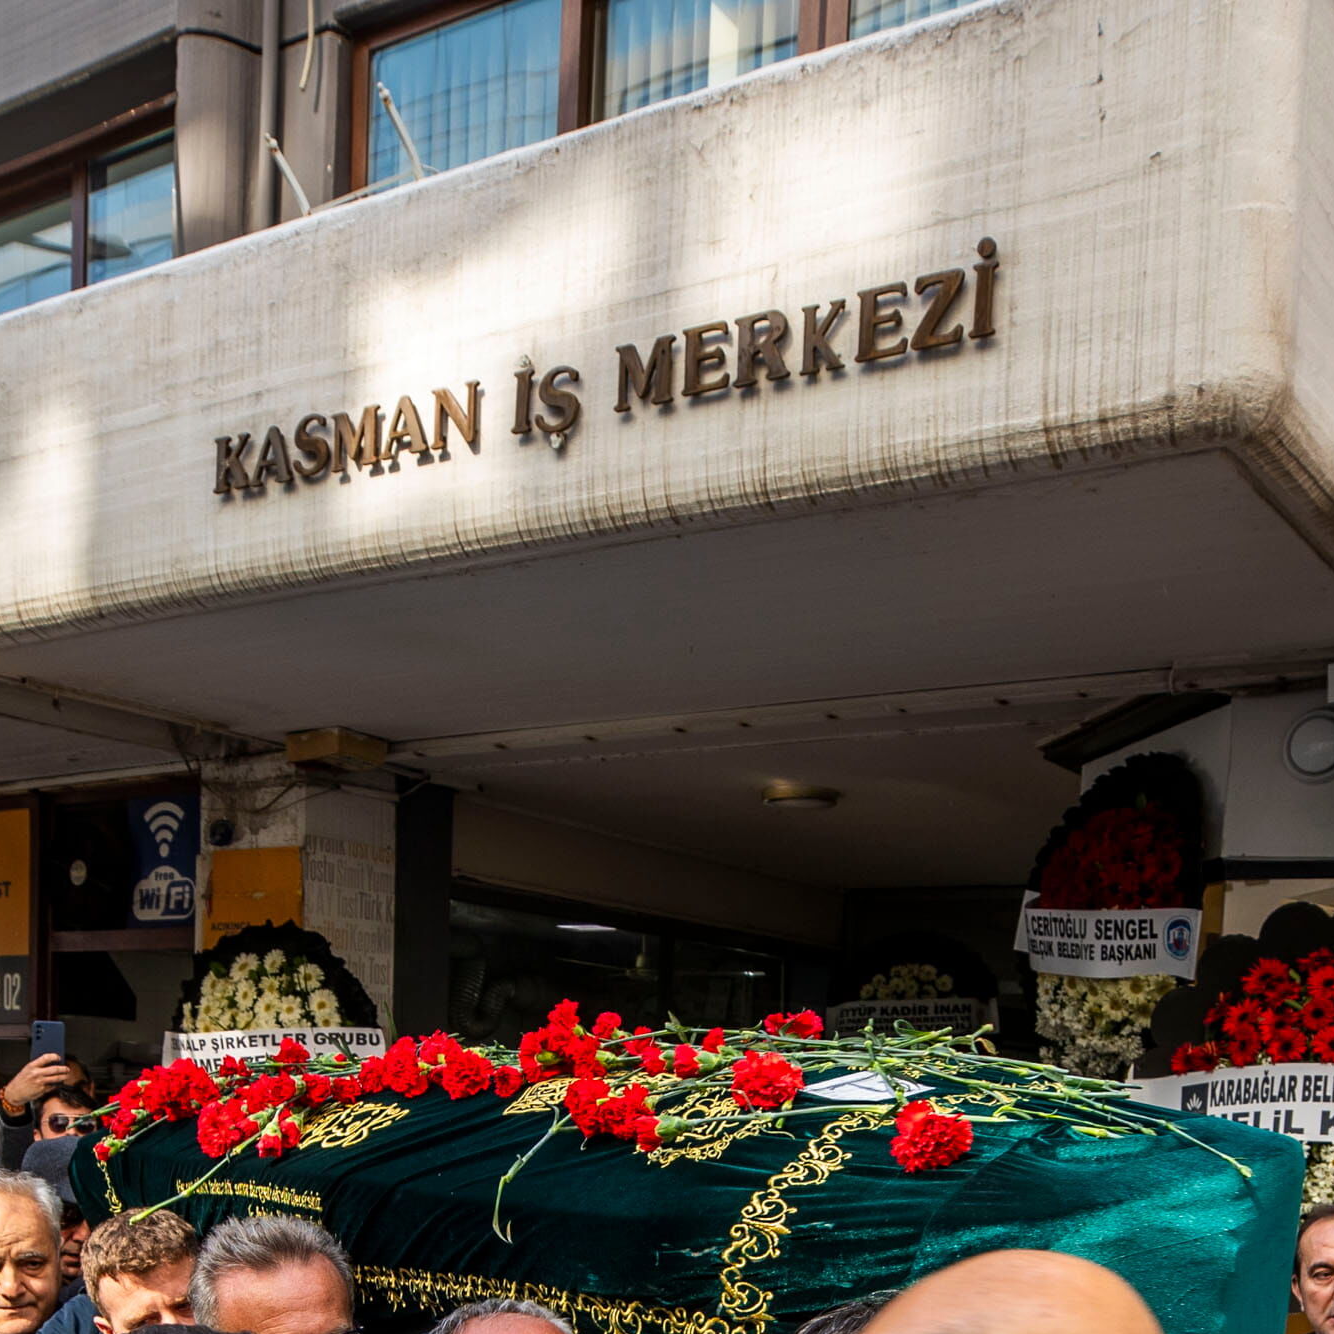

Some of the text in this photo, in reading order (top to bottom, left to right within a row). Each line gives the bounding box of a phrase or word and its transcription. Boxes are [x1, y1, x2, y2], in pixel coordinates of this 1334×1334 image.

[213, 236, 1001, 497] KASMAN İŞ MERKEZİ
[154, 870, 175, 882] Free
[1031, 912, 1087, 939] CERİTOĞLU
[1095, 918, 1158, 941] SENGEL
[1057, 939, 1095, 961] BELEDİYE
[1101, 943, 1156, 965] BAŞKANI
[3, 972, 21, 1012] 02
[880, 1003, 928, 1017] KADİR
[933, 1002, 972, 1015] İNAN
[211, 1031, 307, 1053] ŞİRKETLER
[313, 1031, 381, 1047] GRUBU
[1209, 1071, 1298, 1108] KARABAĞLAR
[1210, 1109, 1305, 1135] ELİL
